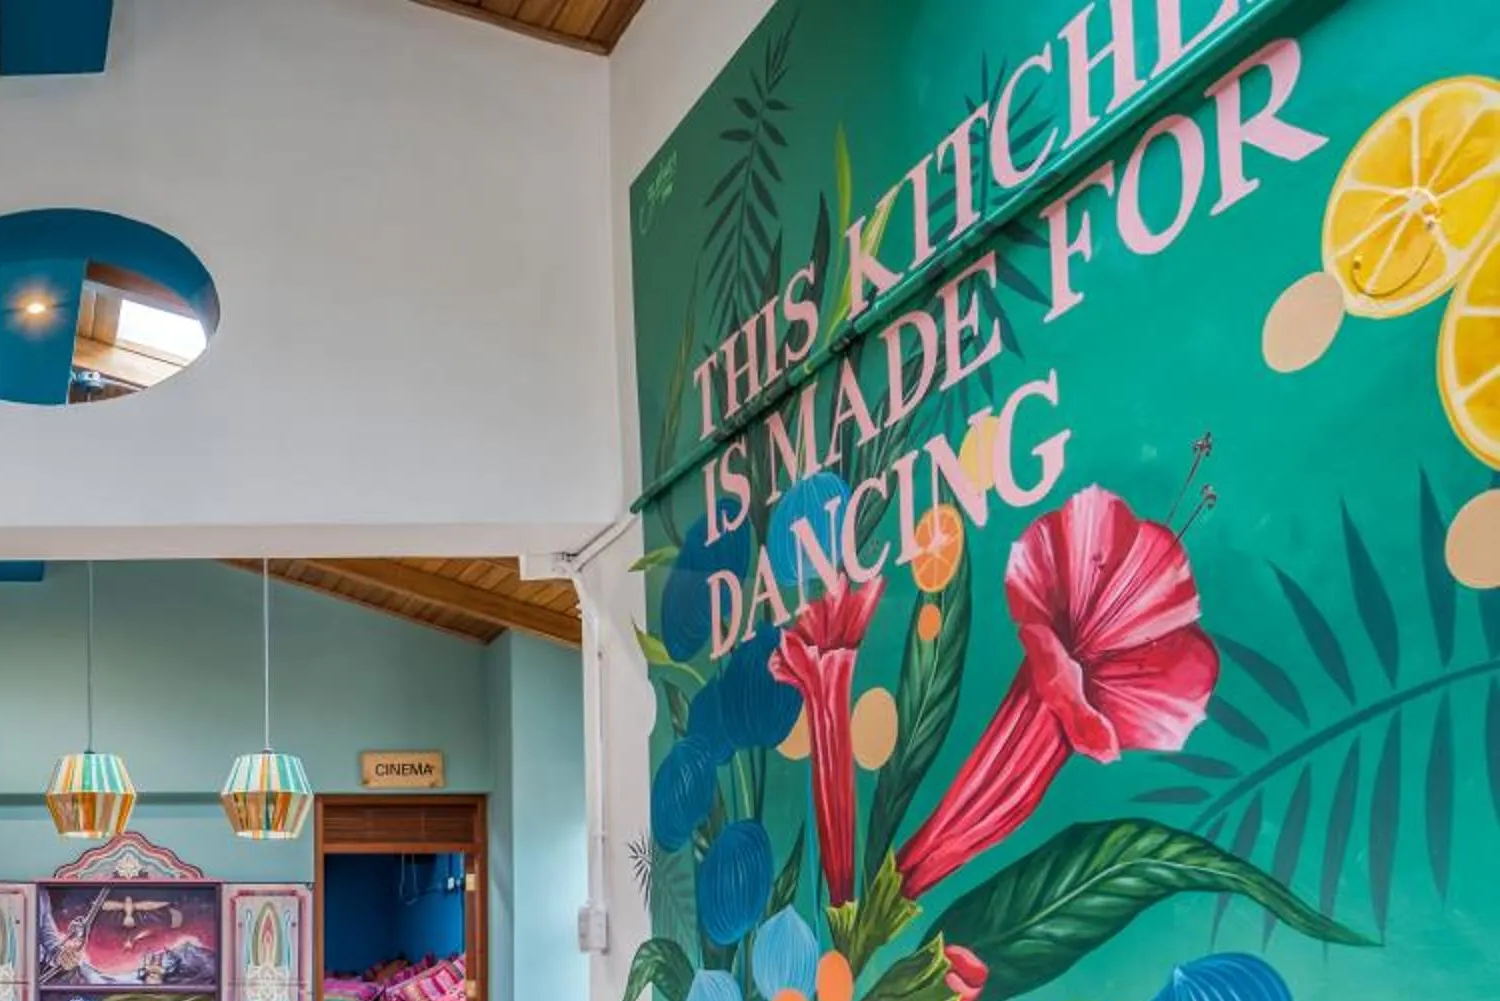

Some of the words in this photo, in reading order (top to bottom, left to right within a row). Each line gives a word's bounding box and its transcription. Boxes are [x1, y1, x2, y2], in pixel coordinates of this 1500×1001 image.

[693, 261, 818, 441] THIS
[702, 431, 751, 546] IS
[764, 251, 1002, 504] MADE
[1040, 38, 1329, 324] FOR
[706, 370, 1070, 661] DANCING
[375, 763, 434, 776] CINEMA
